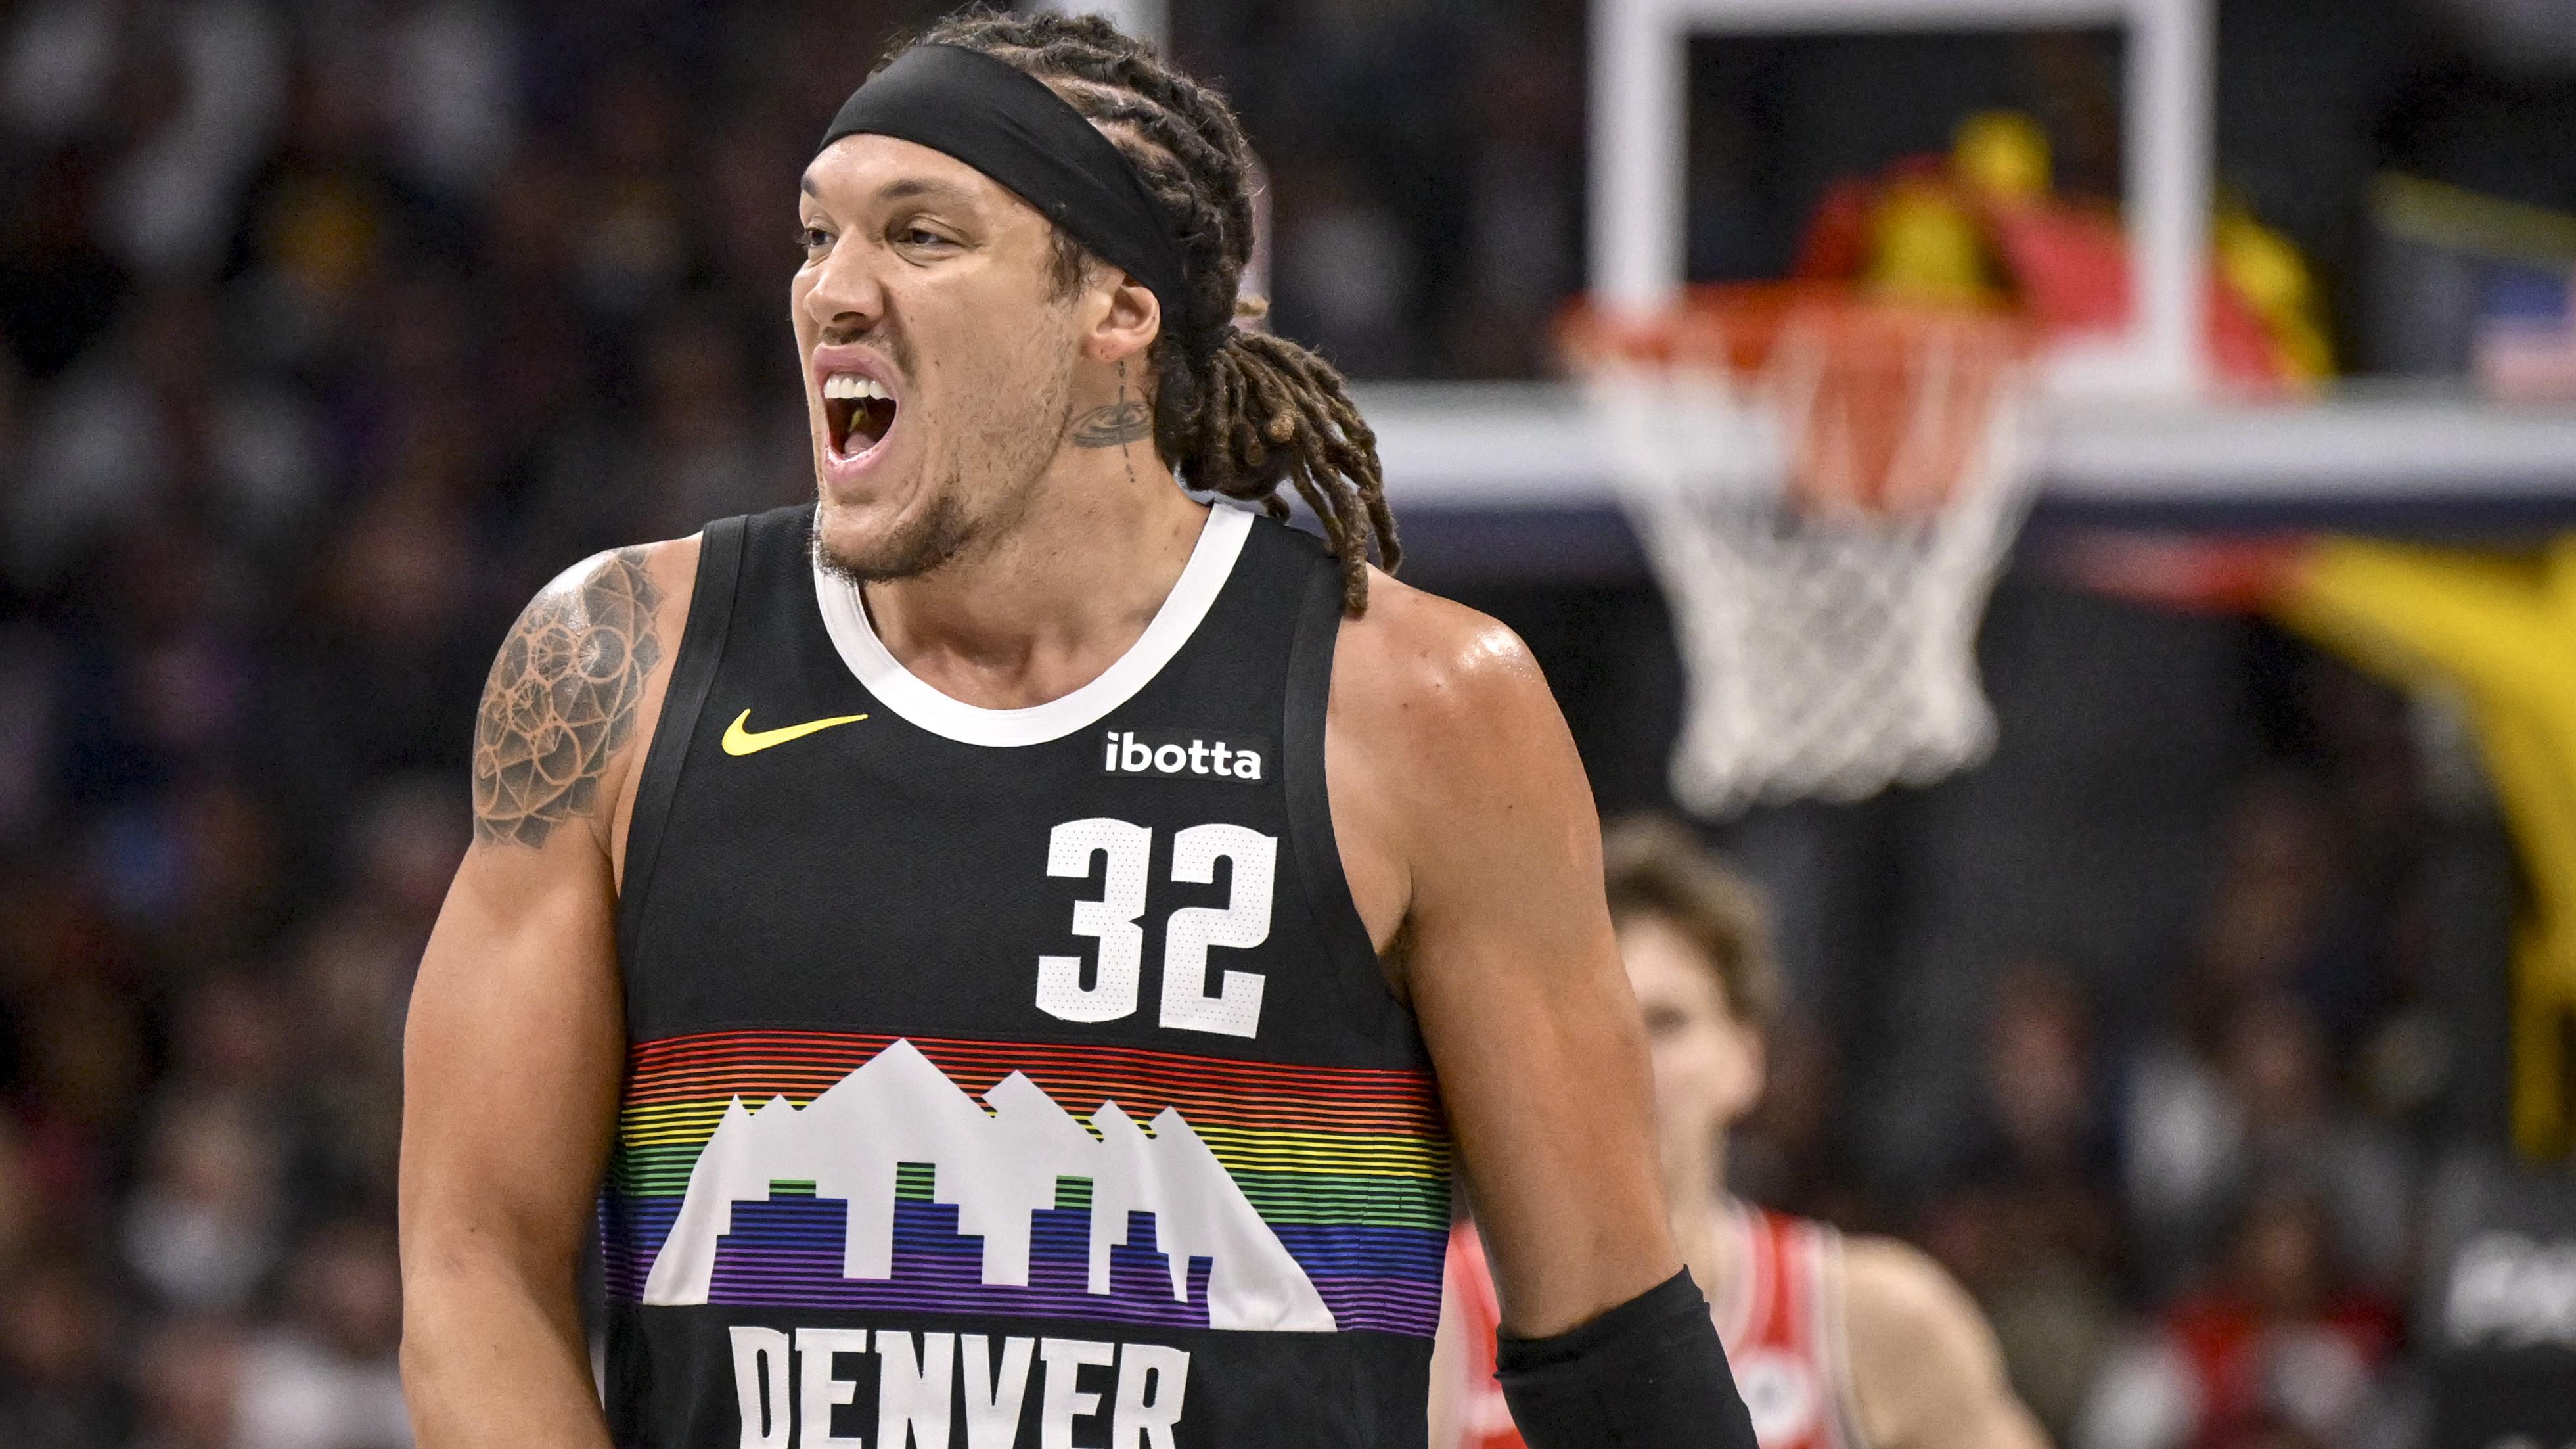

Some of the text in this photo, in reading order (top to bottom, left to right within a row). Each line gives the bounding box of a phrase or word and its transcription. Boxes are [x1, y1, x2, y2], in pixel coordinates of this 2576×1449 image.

[1105, 731, 1261, 780] ibotta
[1035, 817, 1278, 1040] 32
[729, 1326, 1190, 1449] DENVER
